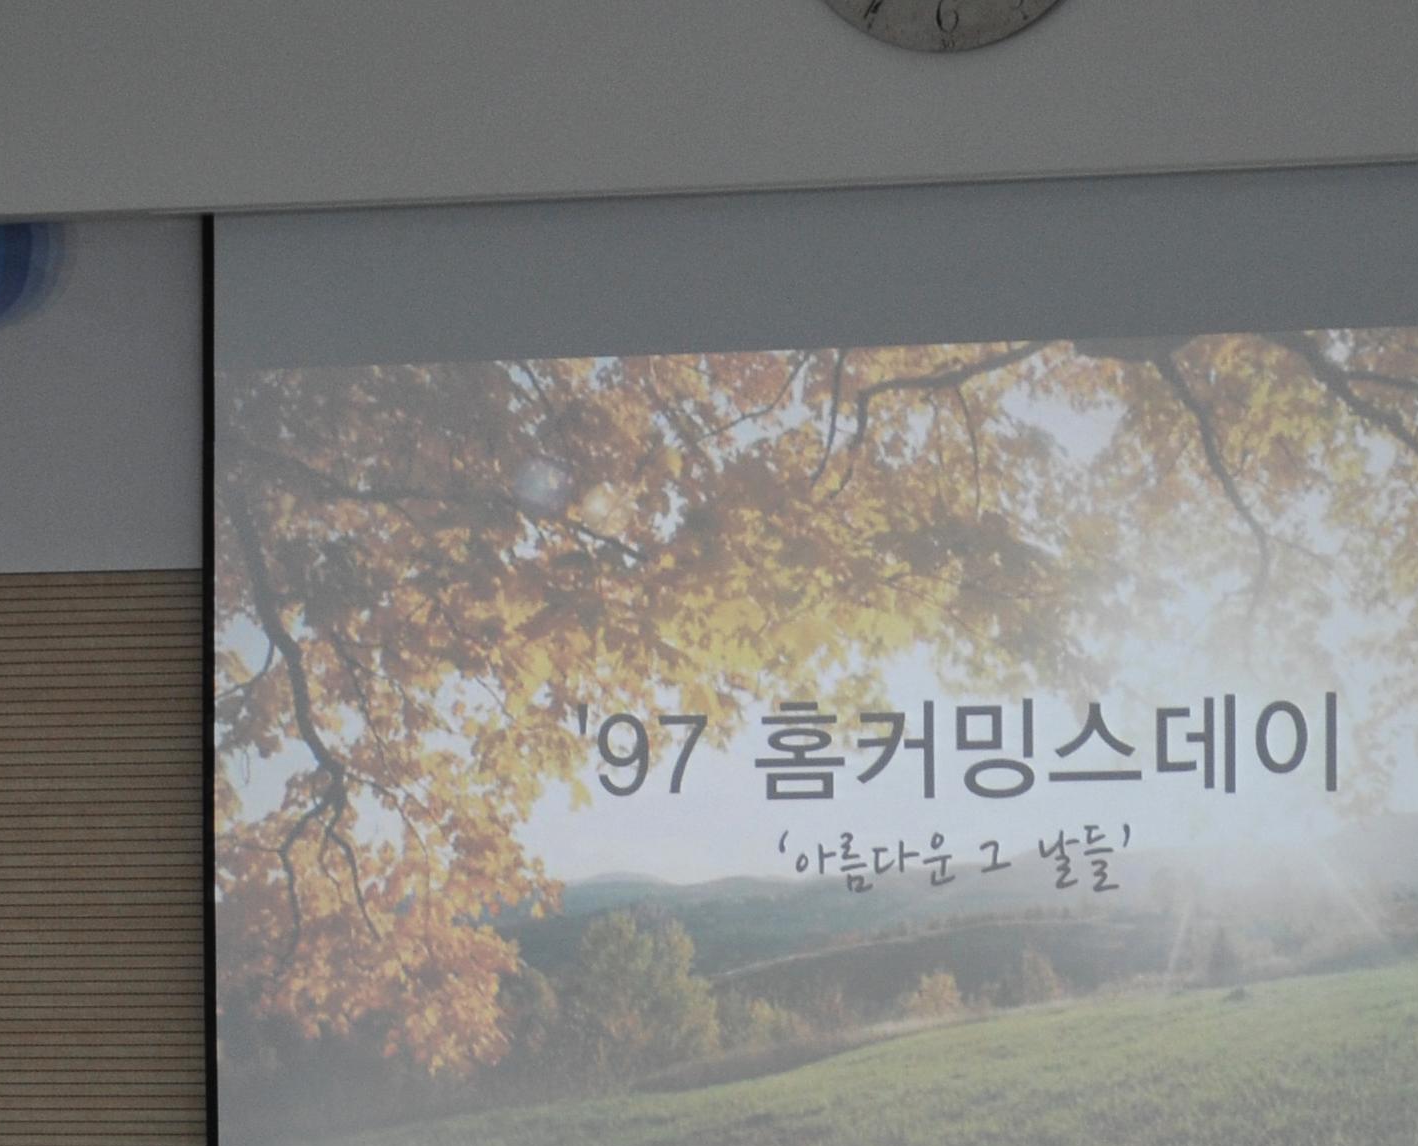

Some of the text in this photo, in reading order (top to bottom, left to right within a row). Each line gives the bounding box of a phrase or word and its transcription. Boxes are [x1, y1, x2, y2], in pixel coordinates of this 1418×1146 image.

[578, 691, 1338, 800] '97 홈커밍스데이
[980, 840, 1012, 873] 그
